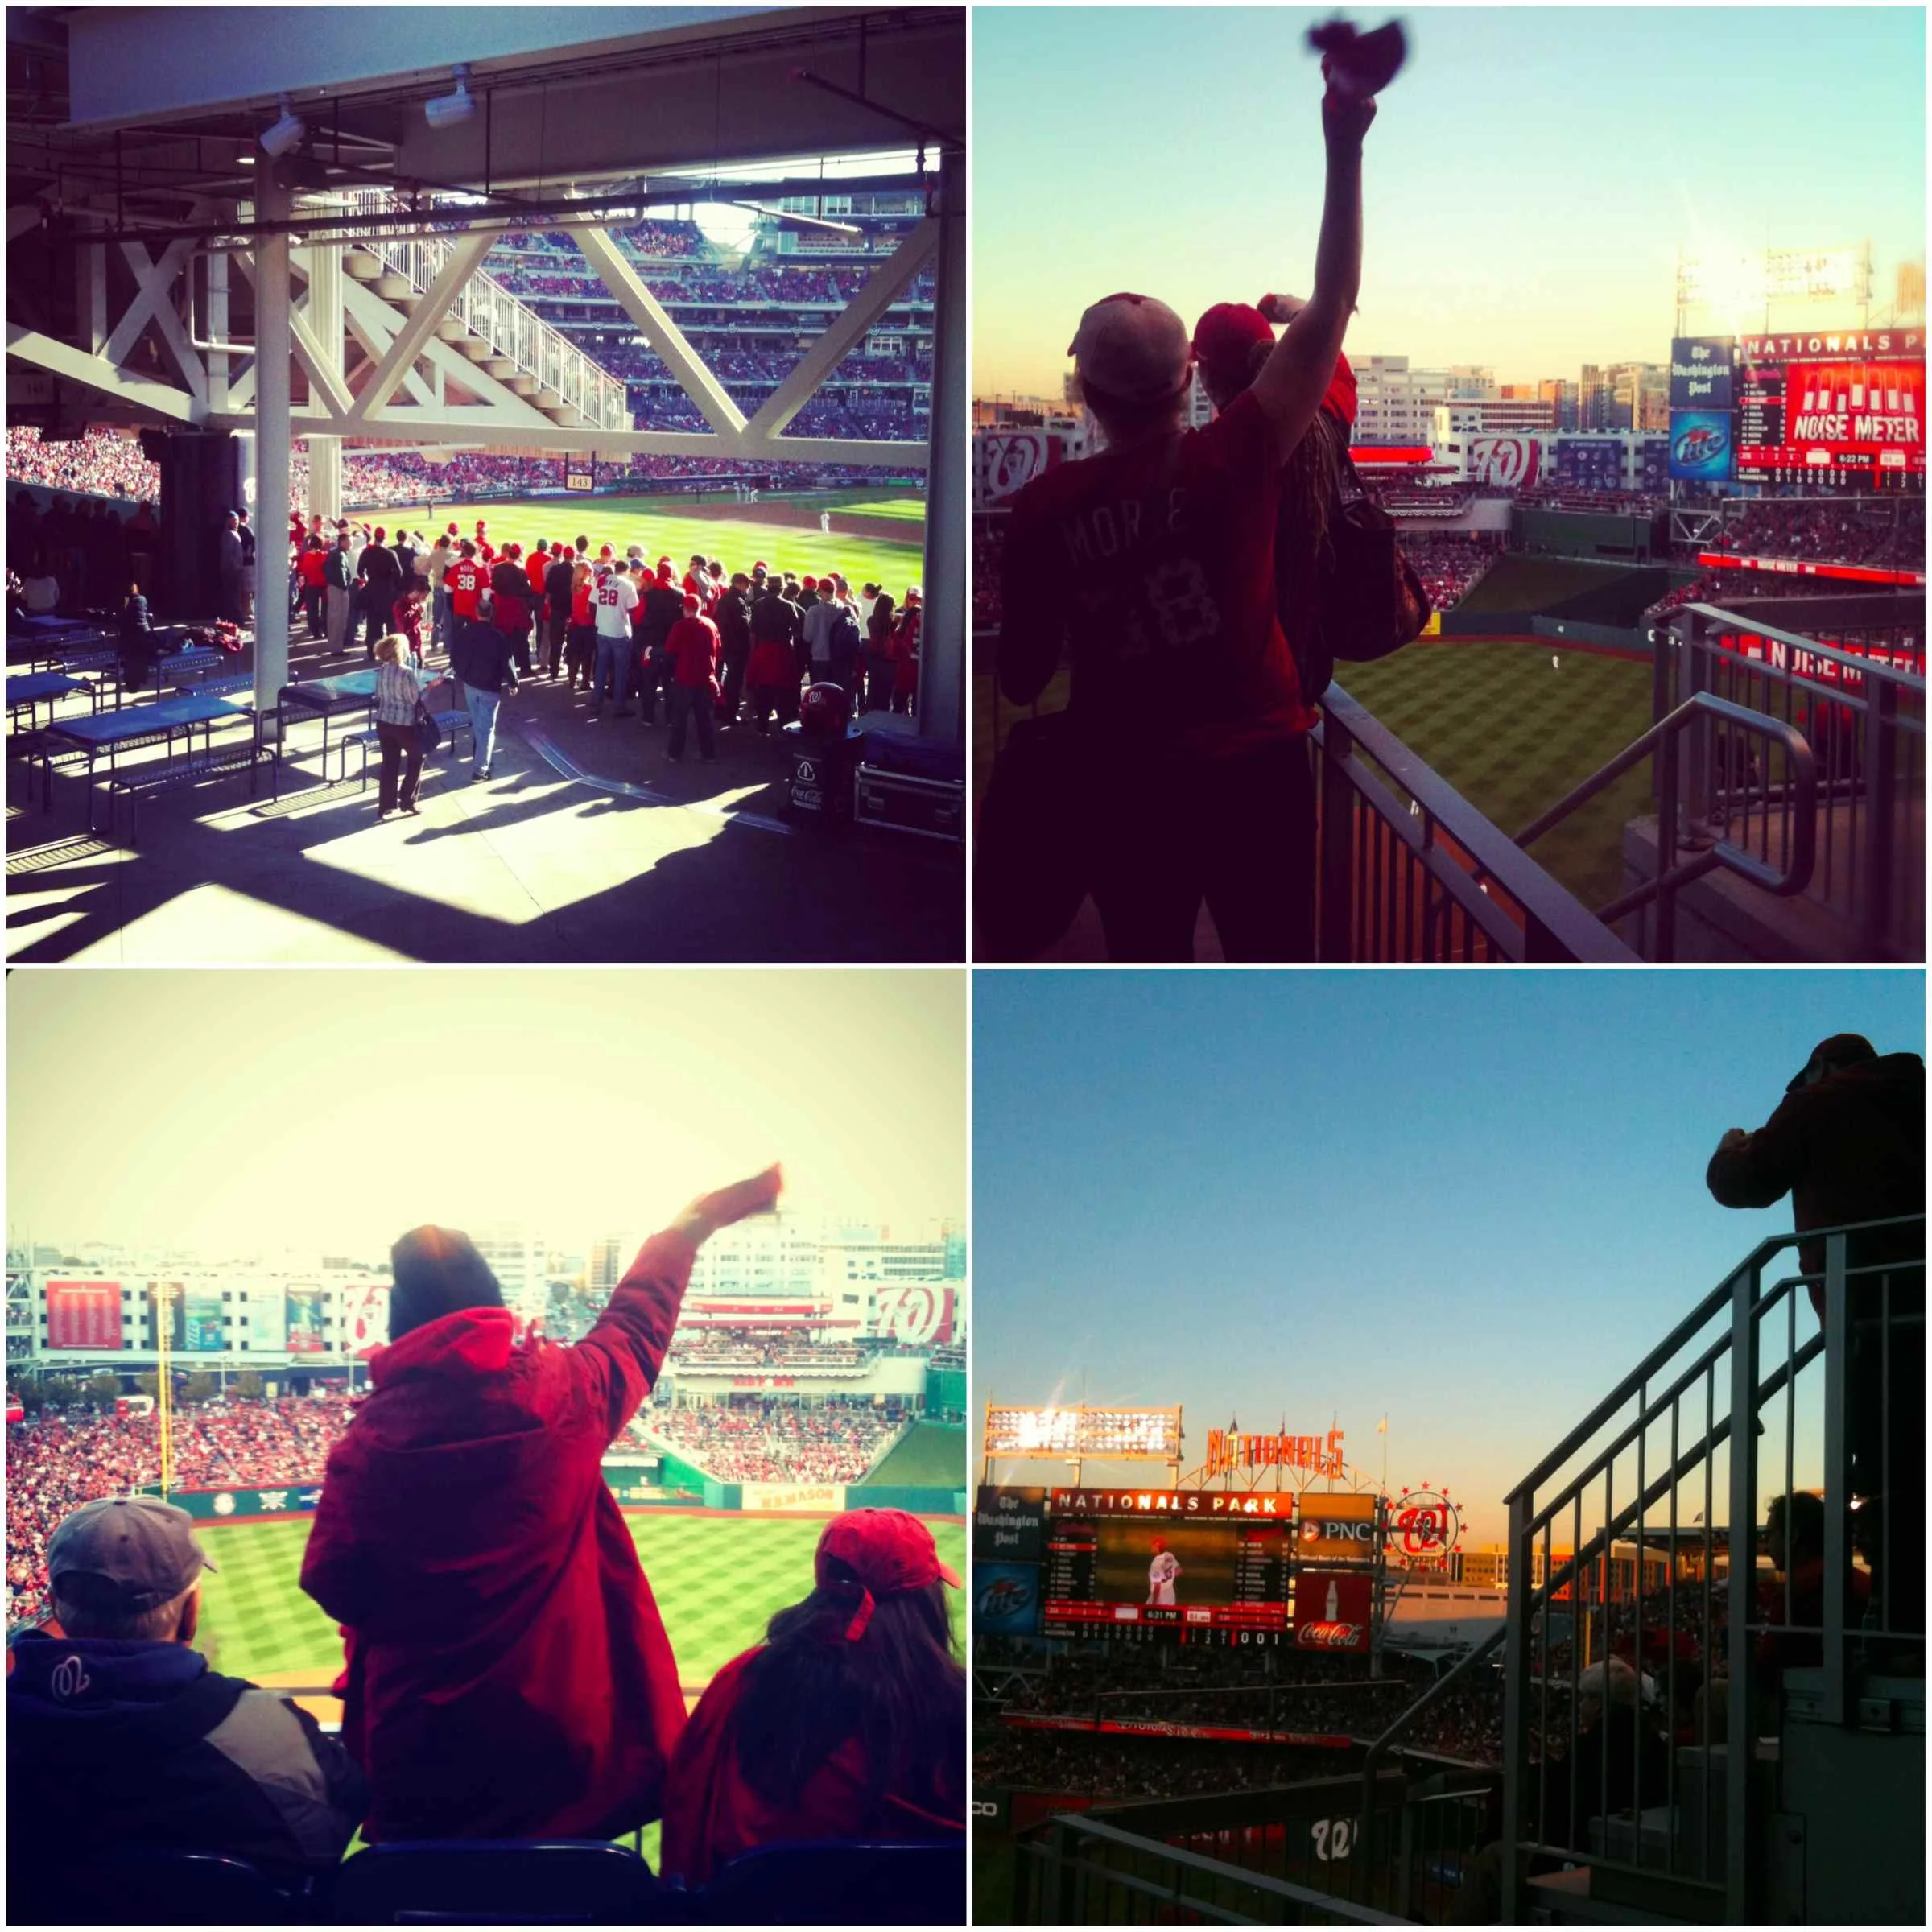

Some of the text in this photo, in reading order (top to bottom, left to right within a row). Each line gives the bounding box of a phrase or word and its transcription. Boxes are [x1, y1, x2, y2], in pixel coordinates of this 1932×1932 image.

[1691, 345, 1711, 360] The
[1748, 335, 1891, 354] NATIONALS
[1672, 362, 1730, 378] Washington
[1688, 380, 1711, 397] Post
[1794, 413, 1849, 441] NOISE
[1854, 414, 1920, 443] METER
[1839, 453, 1856, 464] 6:22
[1857, 454, 1870, 464] PM
[572, 477, 588, 487] 143
[1058, 486, 1191, 568] MORE
[457, 574, 476, 591] 38
[598, 588, 619, 606] 28
[1208, 1429, 1344, 1480] NATIONALS
[998, 1496, 1019, 1510] The
[1059, 1493, 1277, 1514] NATIONALS PARK
[977, 1512, 1039, 1530] Washington
[994, 1530, 1020, 1547] Post
[1324, 1521, 1371, 1541] PNC
[1147, 1610, 1177, 1620] 6:21 PM
[1241, 1632, 1279, 1645] 0 0 1
